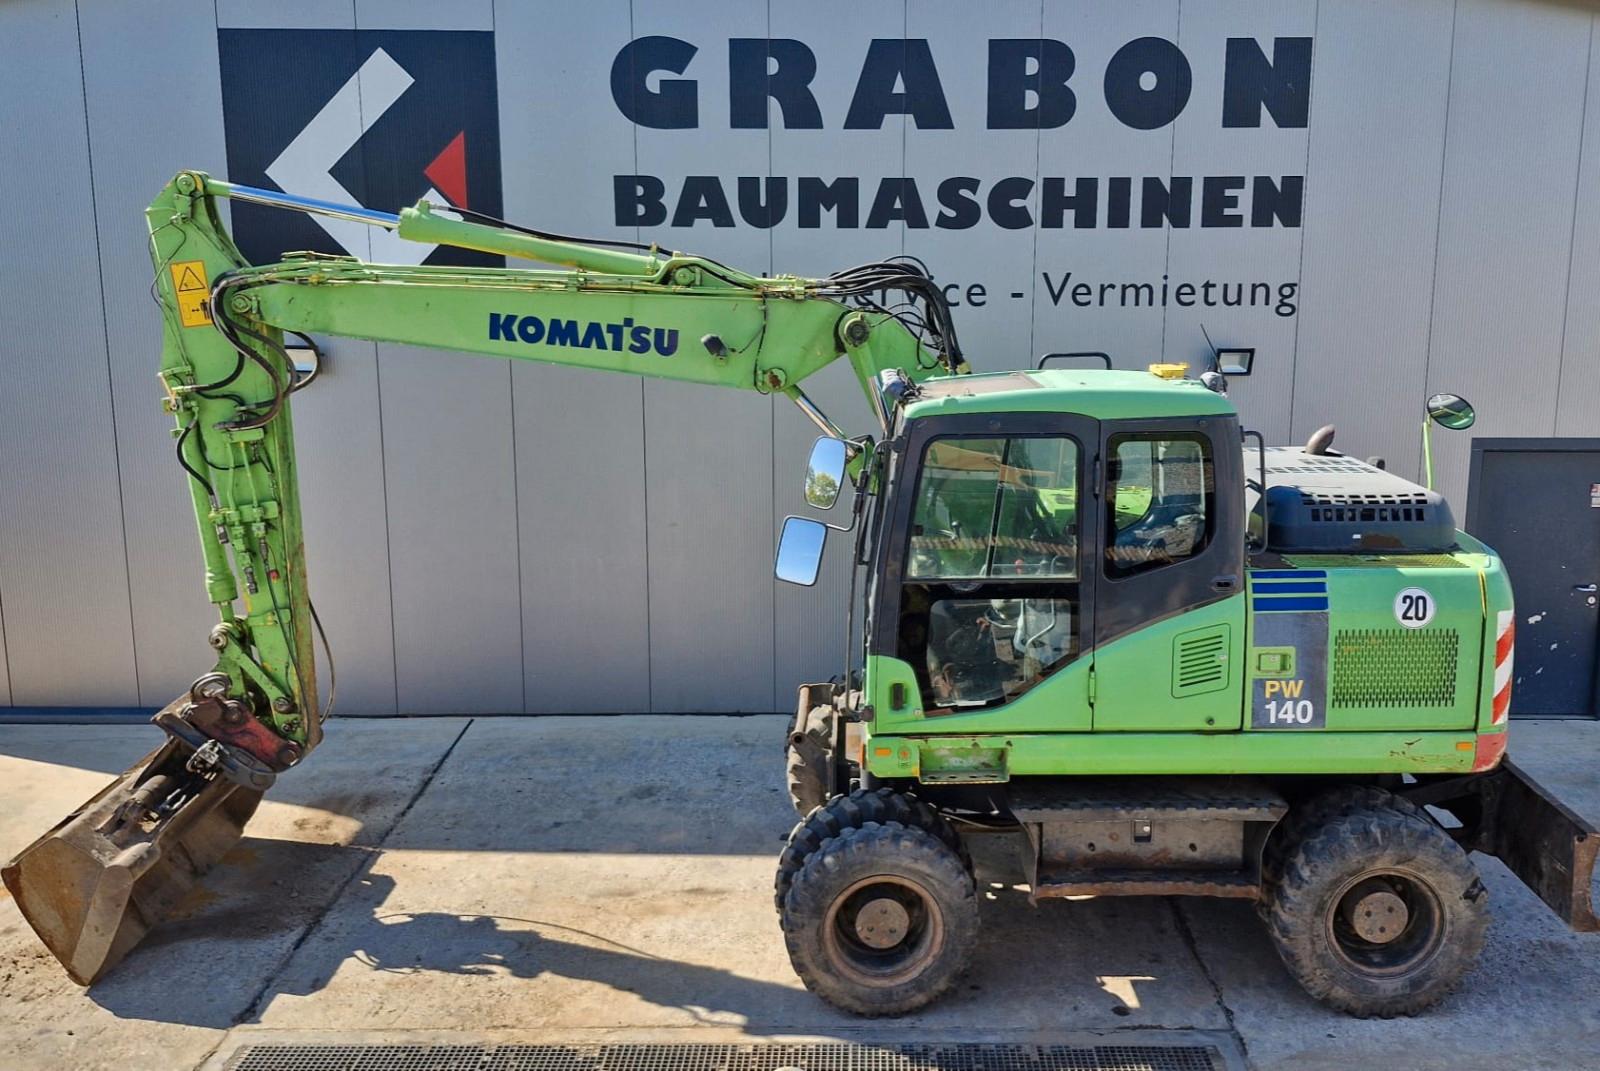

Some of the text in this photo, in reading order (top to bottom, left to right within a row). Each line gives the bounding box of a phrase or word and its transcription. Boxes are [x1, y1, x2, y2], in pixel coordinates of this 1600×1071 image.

[611, 37, 1312, 129] GRABON
[614, 175, 1303, 229] BAUMASCHINEN
[1042, 273, 1299, 317] Vermietung
[489, 312, 679, 357] KOMATSU
[1401, 595, 1427, 621] 20
[1264, 680, 1304, 699] PW
[1265, 700, 1313, 724] 140
